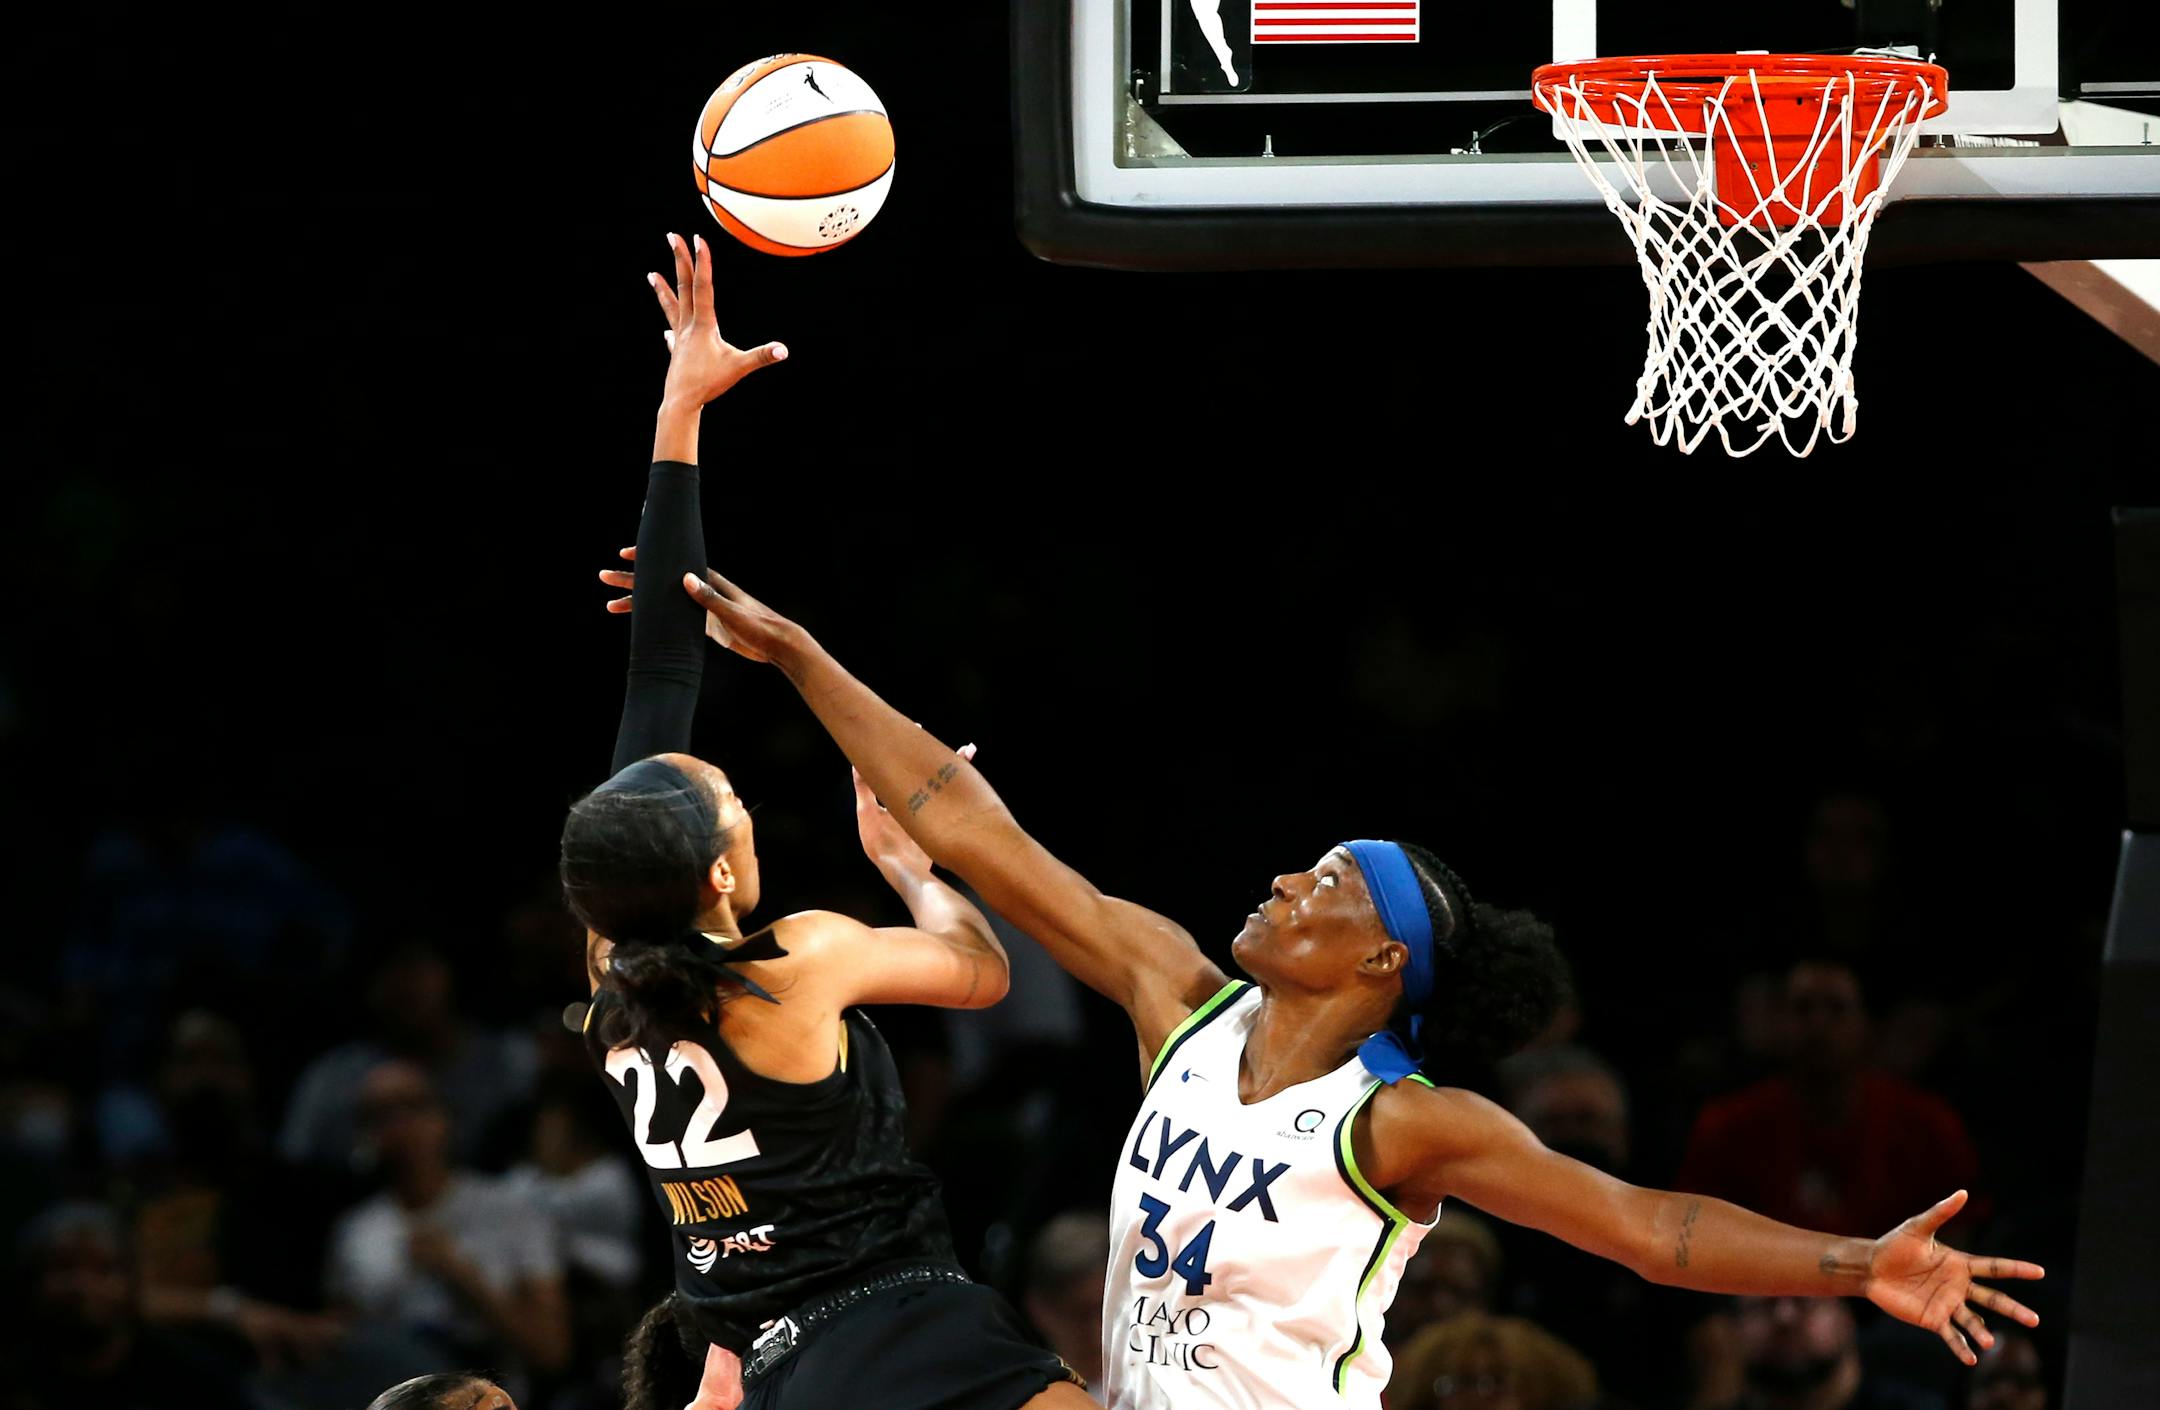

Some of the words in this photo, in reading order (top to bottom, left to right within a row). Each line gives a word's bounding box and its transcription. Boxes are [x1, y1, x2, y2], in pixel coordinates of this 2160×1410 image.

[604, 1039, 761, 1170] 22
[661, 1174, 749, 1226] WILSON
[1129, 1110, 1291, 1223] LYNX
[1134, 1192, 1216, 1296] 34
